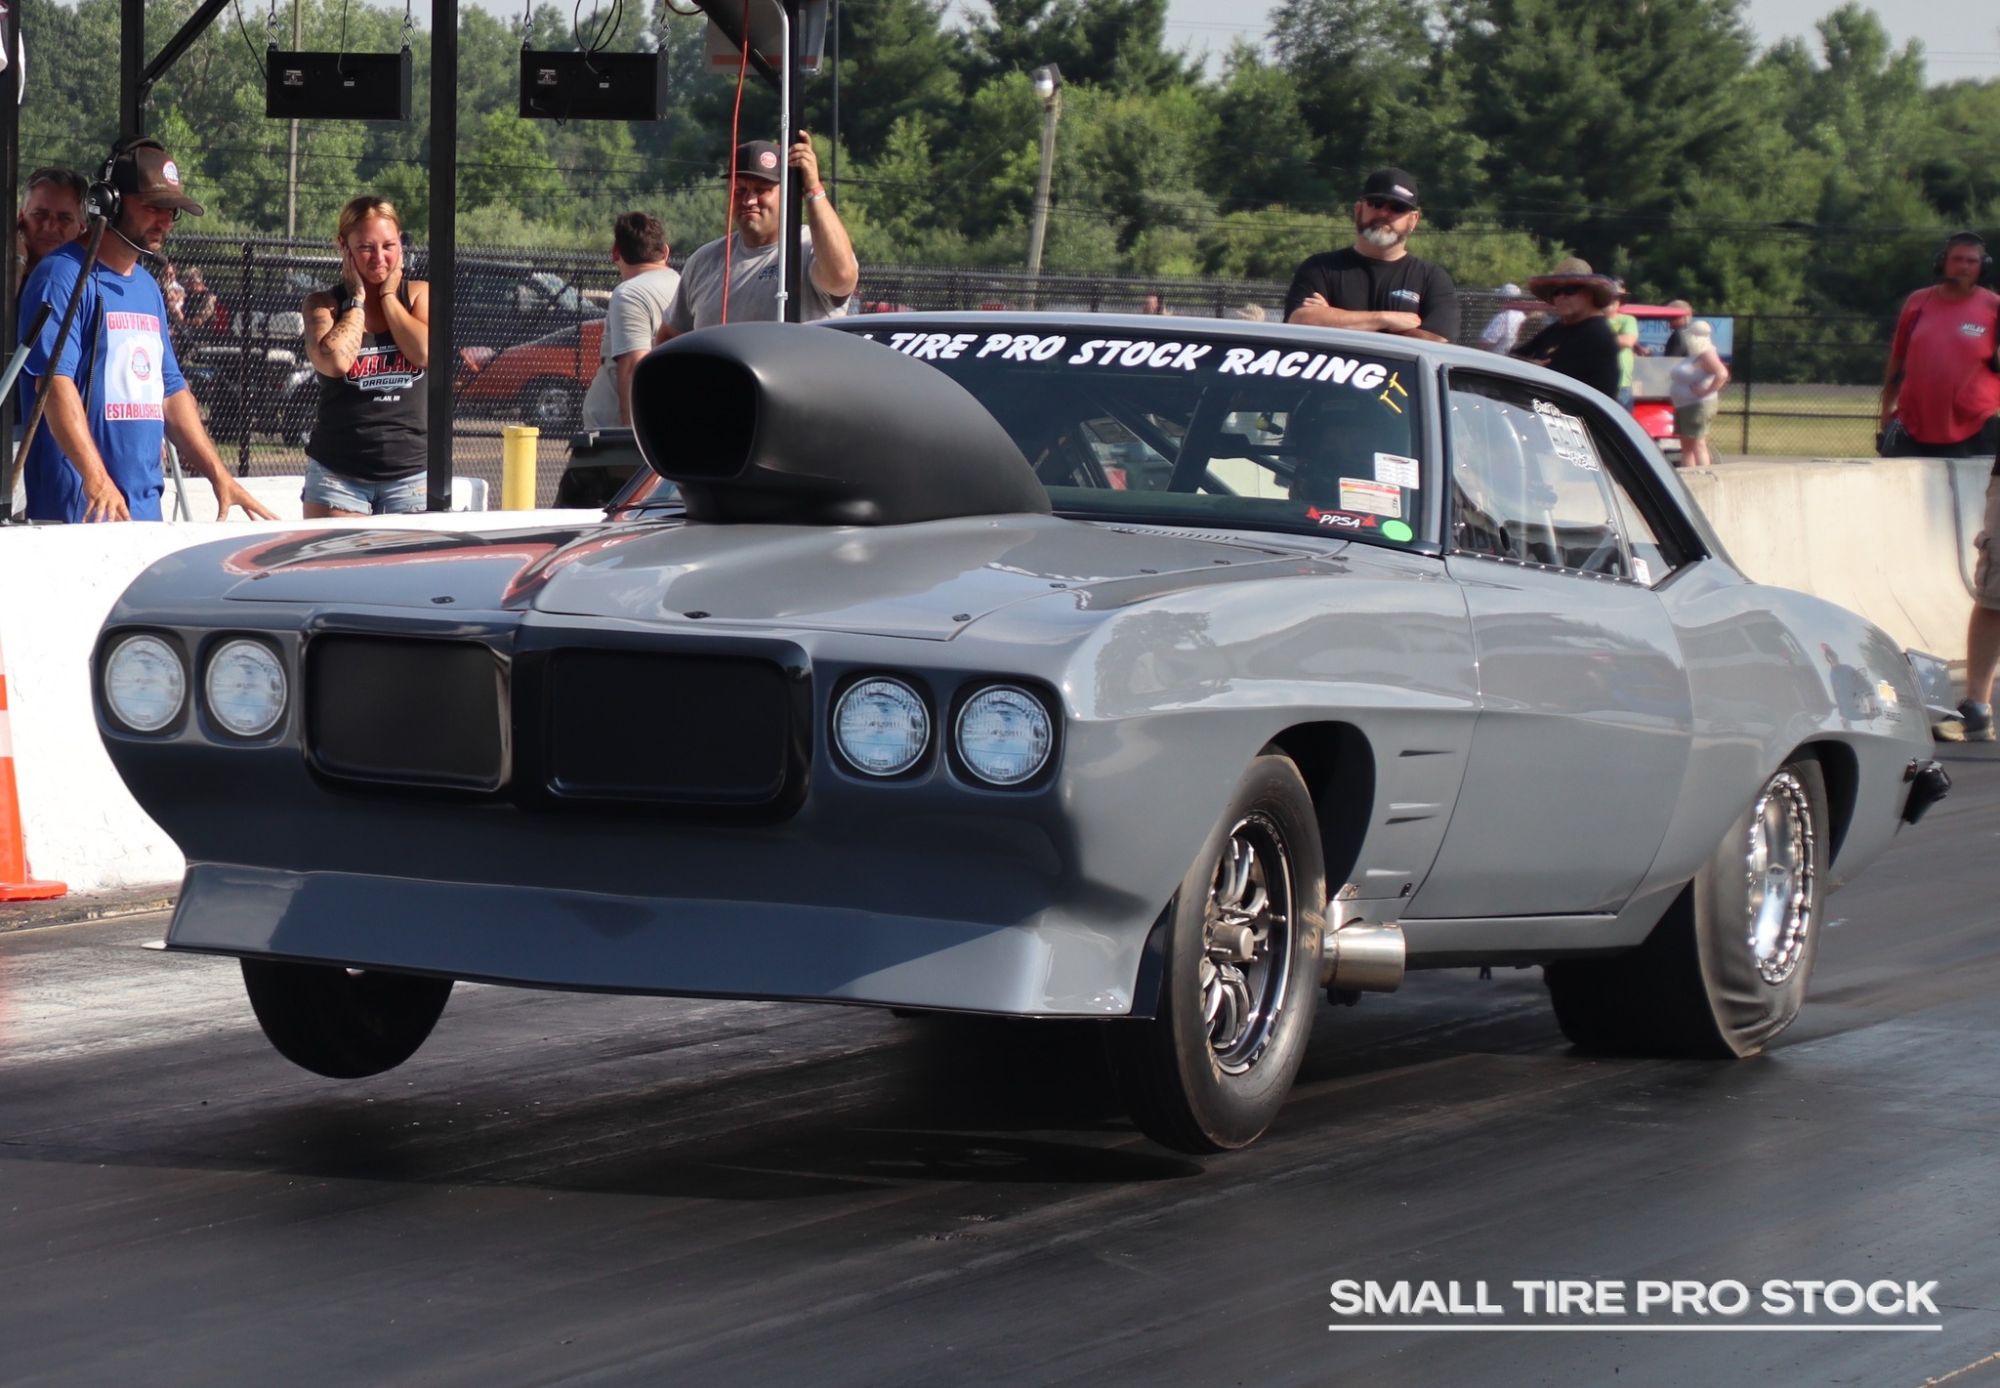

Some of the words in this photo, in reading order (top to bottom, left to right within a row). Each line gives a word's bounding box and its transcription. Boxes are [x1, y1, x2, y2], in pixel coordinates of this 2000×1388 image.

[890, 333, 978, 360] TIRE
[976, 333, 1066, 361] PRO
[1068, 340, 1212, 371] STOCK
[1218, 348, 1388, 389] RACING
[362, 376, 410, 388] DRAGWAY
[1319, 514, 1361, 528] PPSA
